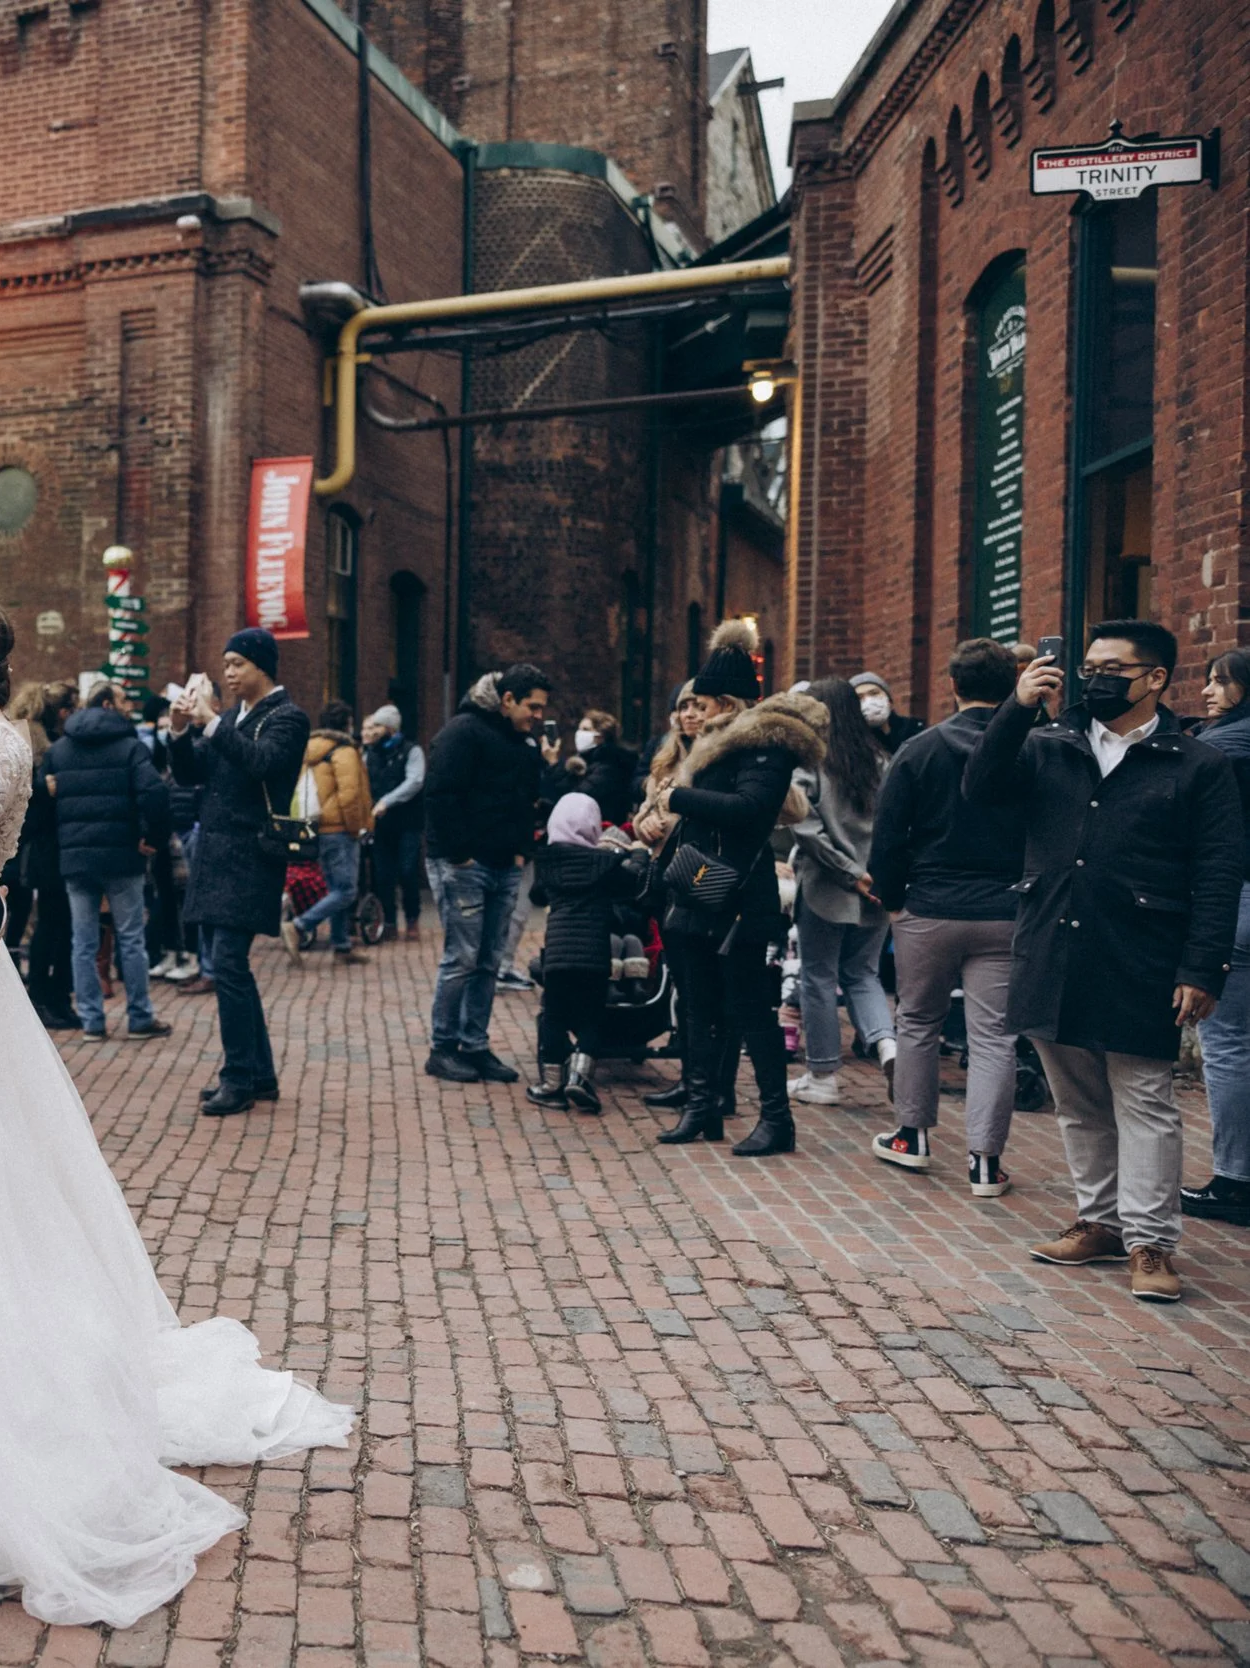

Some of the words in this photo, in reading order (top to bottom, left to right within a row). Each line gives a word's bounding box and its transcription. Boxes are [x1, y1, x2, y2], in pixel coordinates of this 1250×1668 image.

[1041, 158, 1065, 168] THE
[1068, 153, 1136, 166] DISTILLERY
[1137, 149, 1193, 161] DISTRICT
[1076, 165, 1158, 184] TRINITY
[1095, 186, 1138, 197] STREET
[261, 470, 300, 529] JOHN
